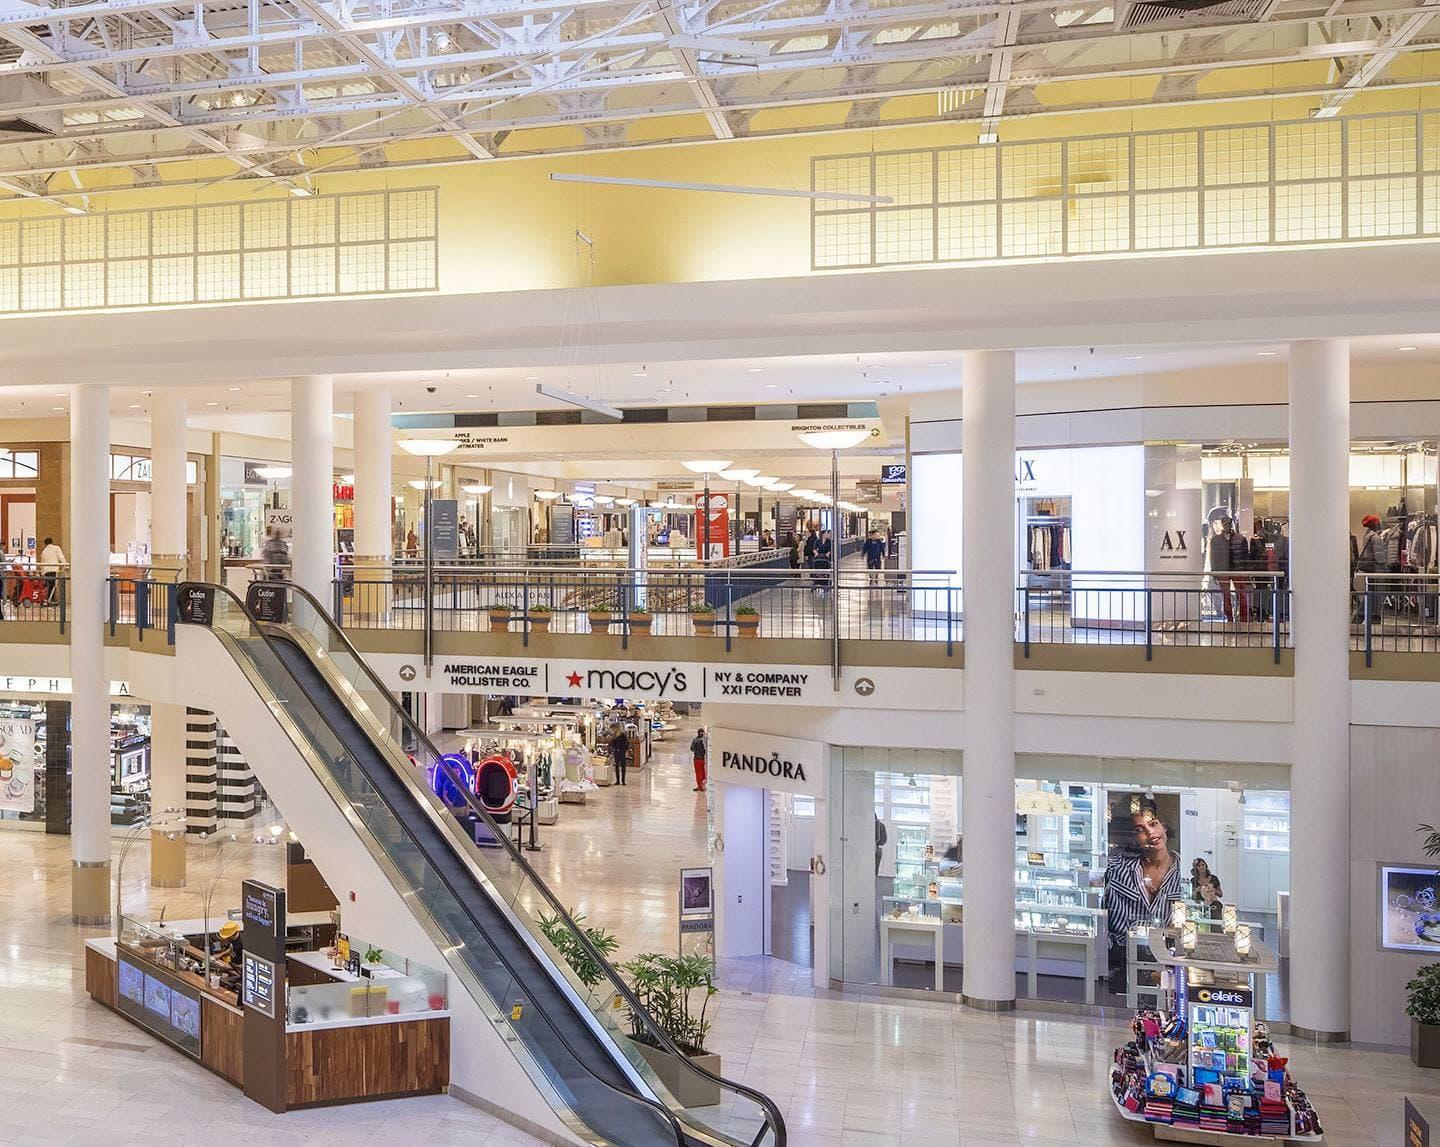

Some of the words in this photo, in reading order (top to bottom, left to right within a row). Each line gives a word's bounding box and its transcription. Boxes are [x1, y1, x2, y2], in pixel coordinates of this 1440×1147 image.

[137, 462, 152, 479] ZAL
[188, 590, 206, 599] Caution
[257, 589, 275, 598] Caution
[444, 665, 500, 676] AMERICAN
[503, 667, 538, 676] EAGLE
[451, 676, 509, 687] HOLLISTER
[512, 678, 530, 688] CO.
[587, 667, 687, 697] macy's
[715, 672, 732, 682] NY
[735, 673, 744, 682] &
[747, 673, 809, 684] COMPANY
[722, 685, 742, 695] XXI
[745, 685, 801, 697] FOREVER
[722, 751, 806, 781] PANDORA
